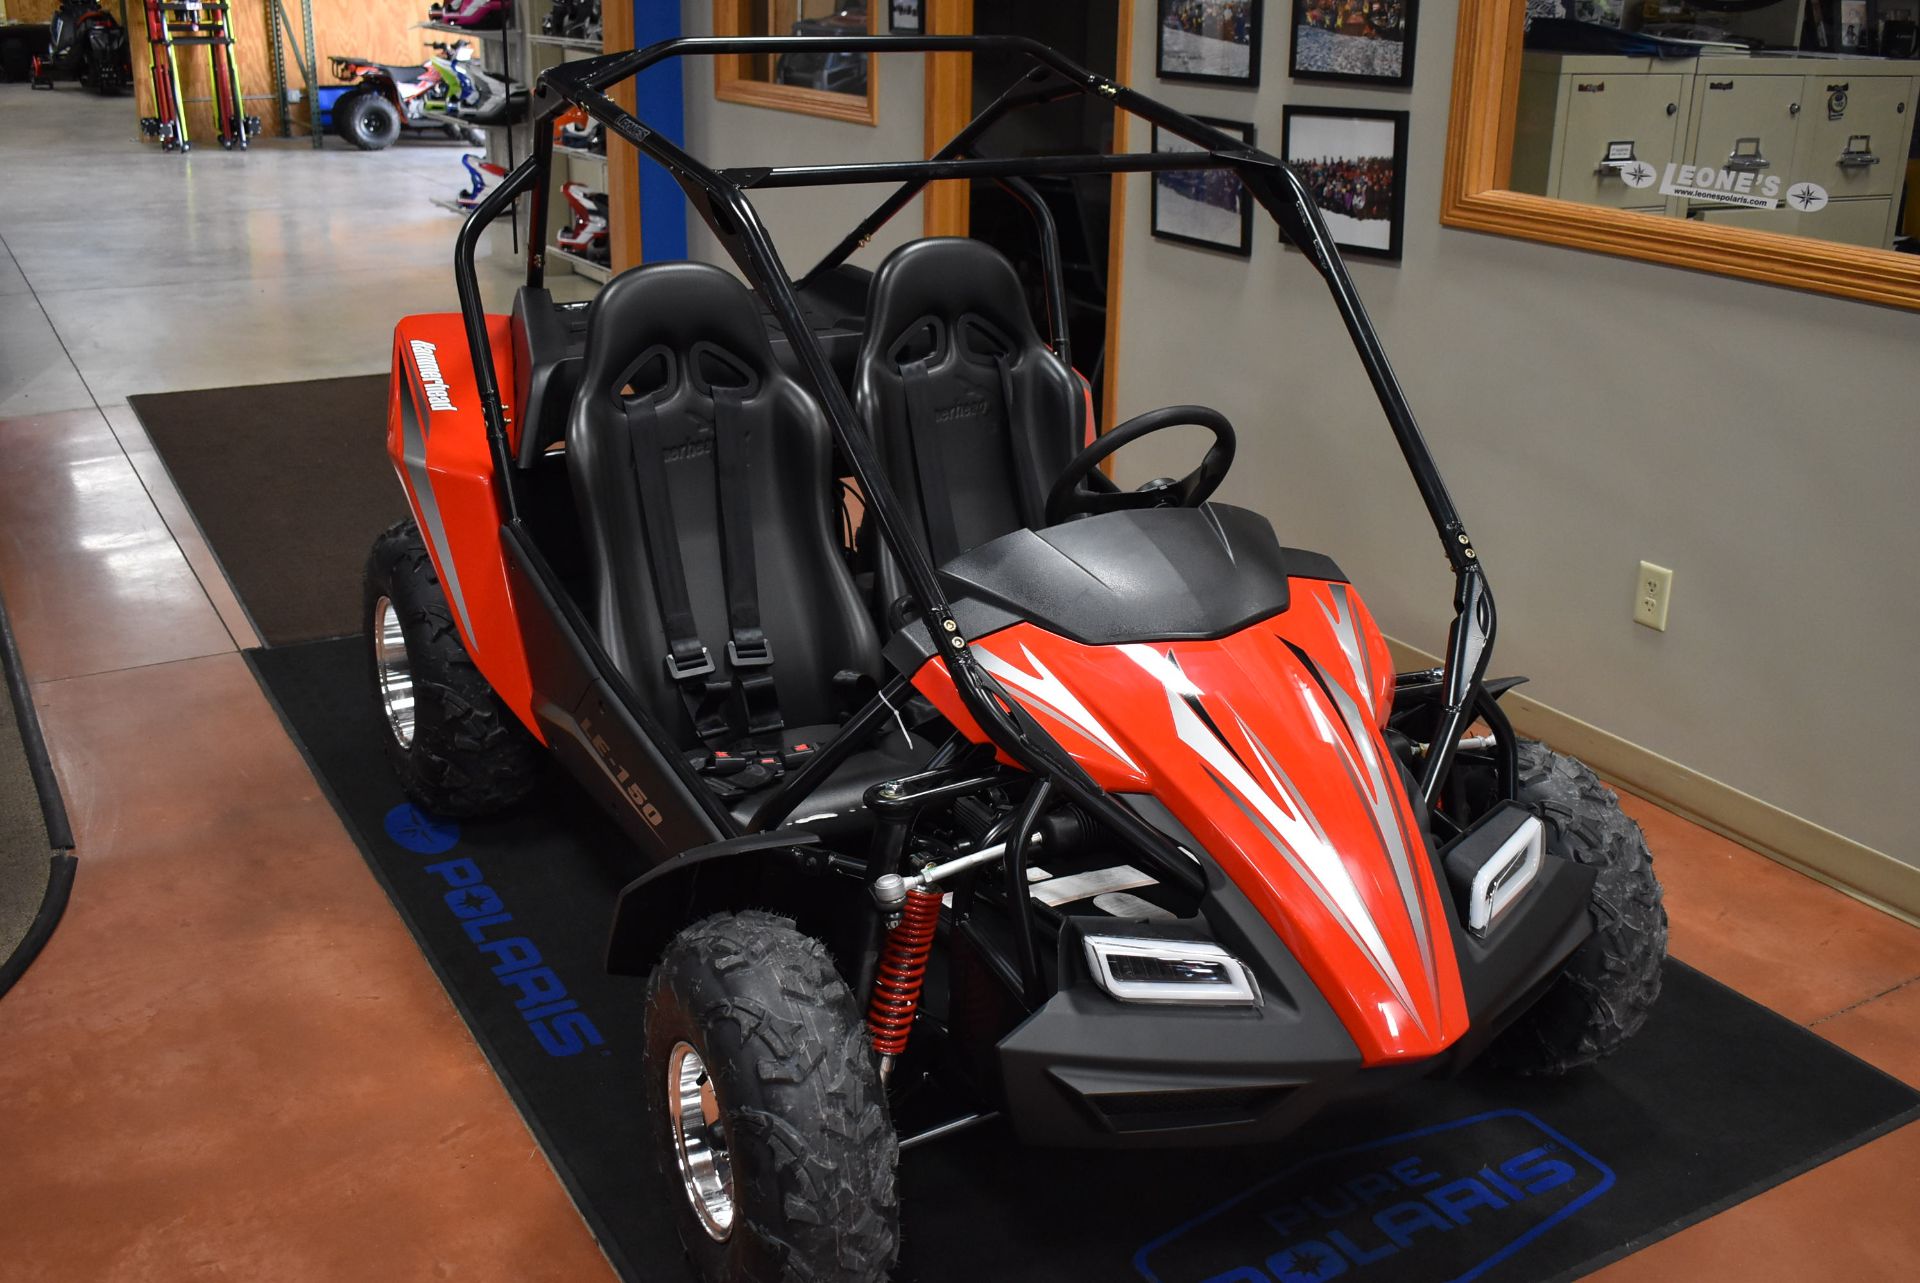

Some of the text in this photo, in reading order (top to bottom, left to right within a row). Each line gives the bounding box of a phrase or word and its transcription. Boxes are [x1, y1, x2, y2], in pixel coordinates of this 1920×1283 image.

[1658, 162, 1781, 197] LEONE'S
[1673, 187, 1768, 208] www.leonespolaris.com
[409, 339, 458, 412] Hammerhead
[580, 718, 664, 827] LE-150
[424, 857, 608, 1058] POLARIS
[1266, 1155, 1442, 1237] PURE
